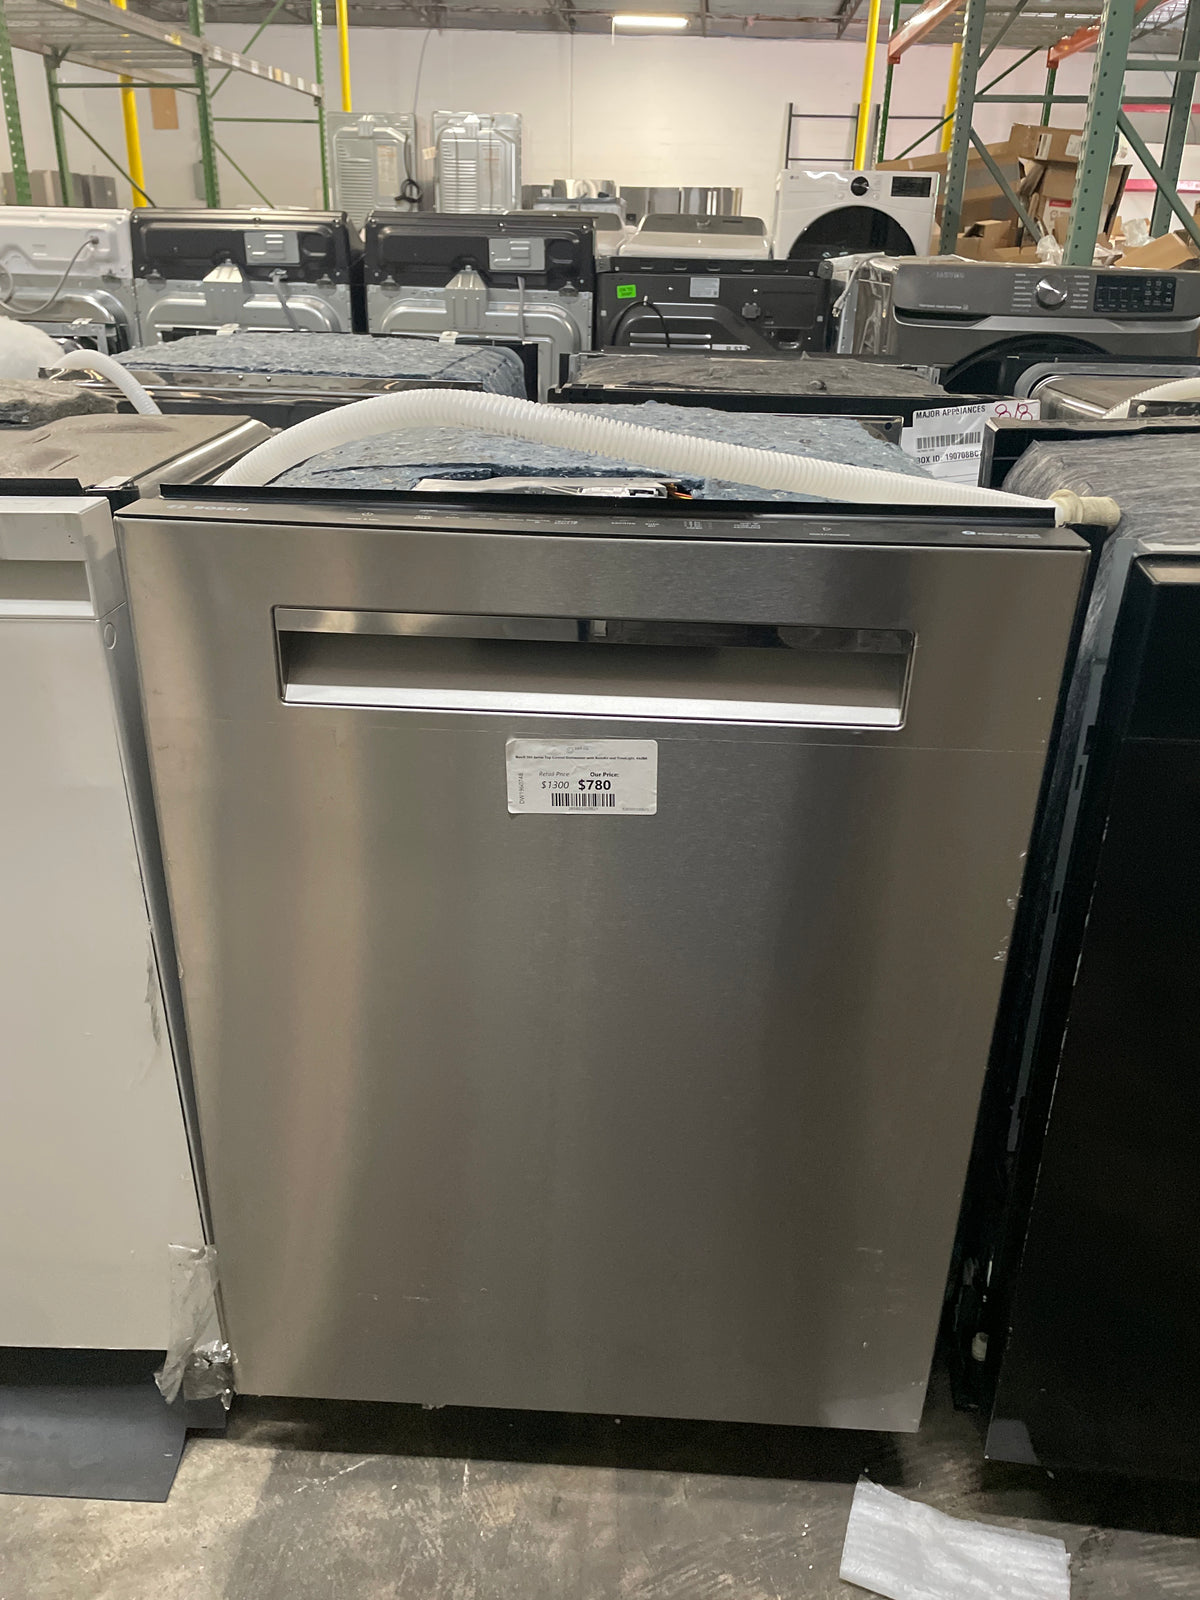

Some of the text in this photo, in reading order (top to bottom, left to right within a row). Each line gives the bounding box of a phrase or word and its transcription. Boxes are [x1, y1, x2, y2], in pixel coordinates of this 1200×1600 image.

[916, 405, 986, 419] MAJOR APPLIANCES
[541, 780, 570, 790] $1300
[578, 779, 612, 791] $780
